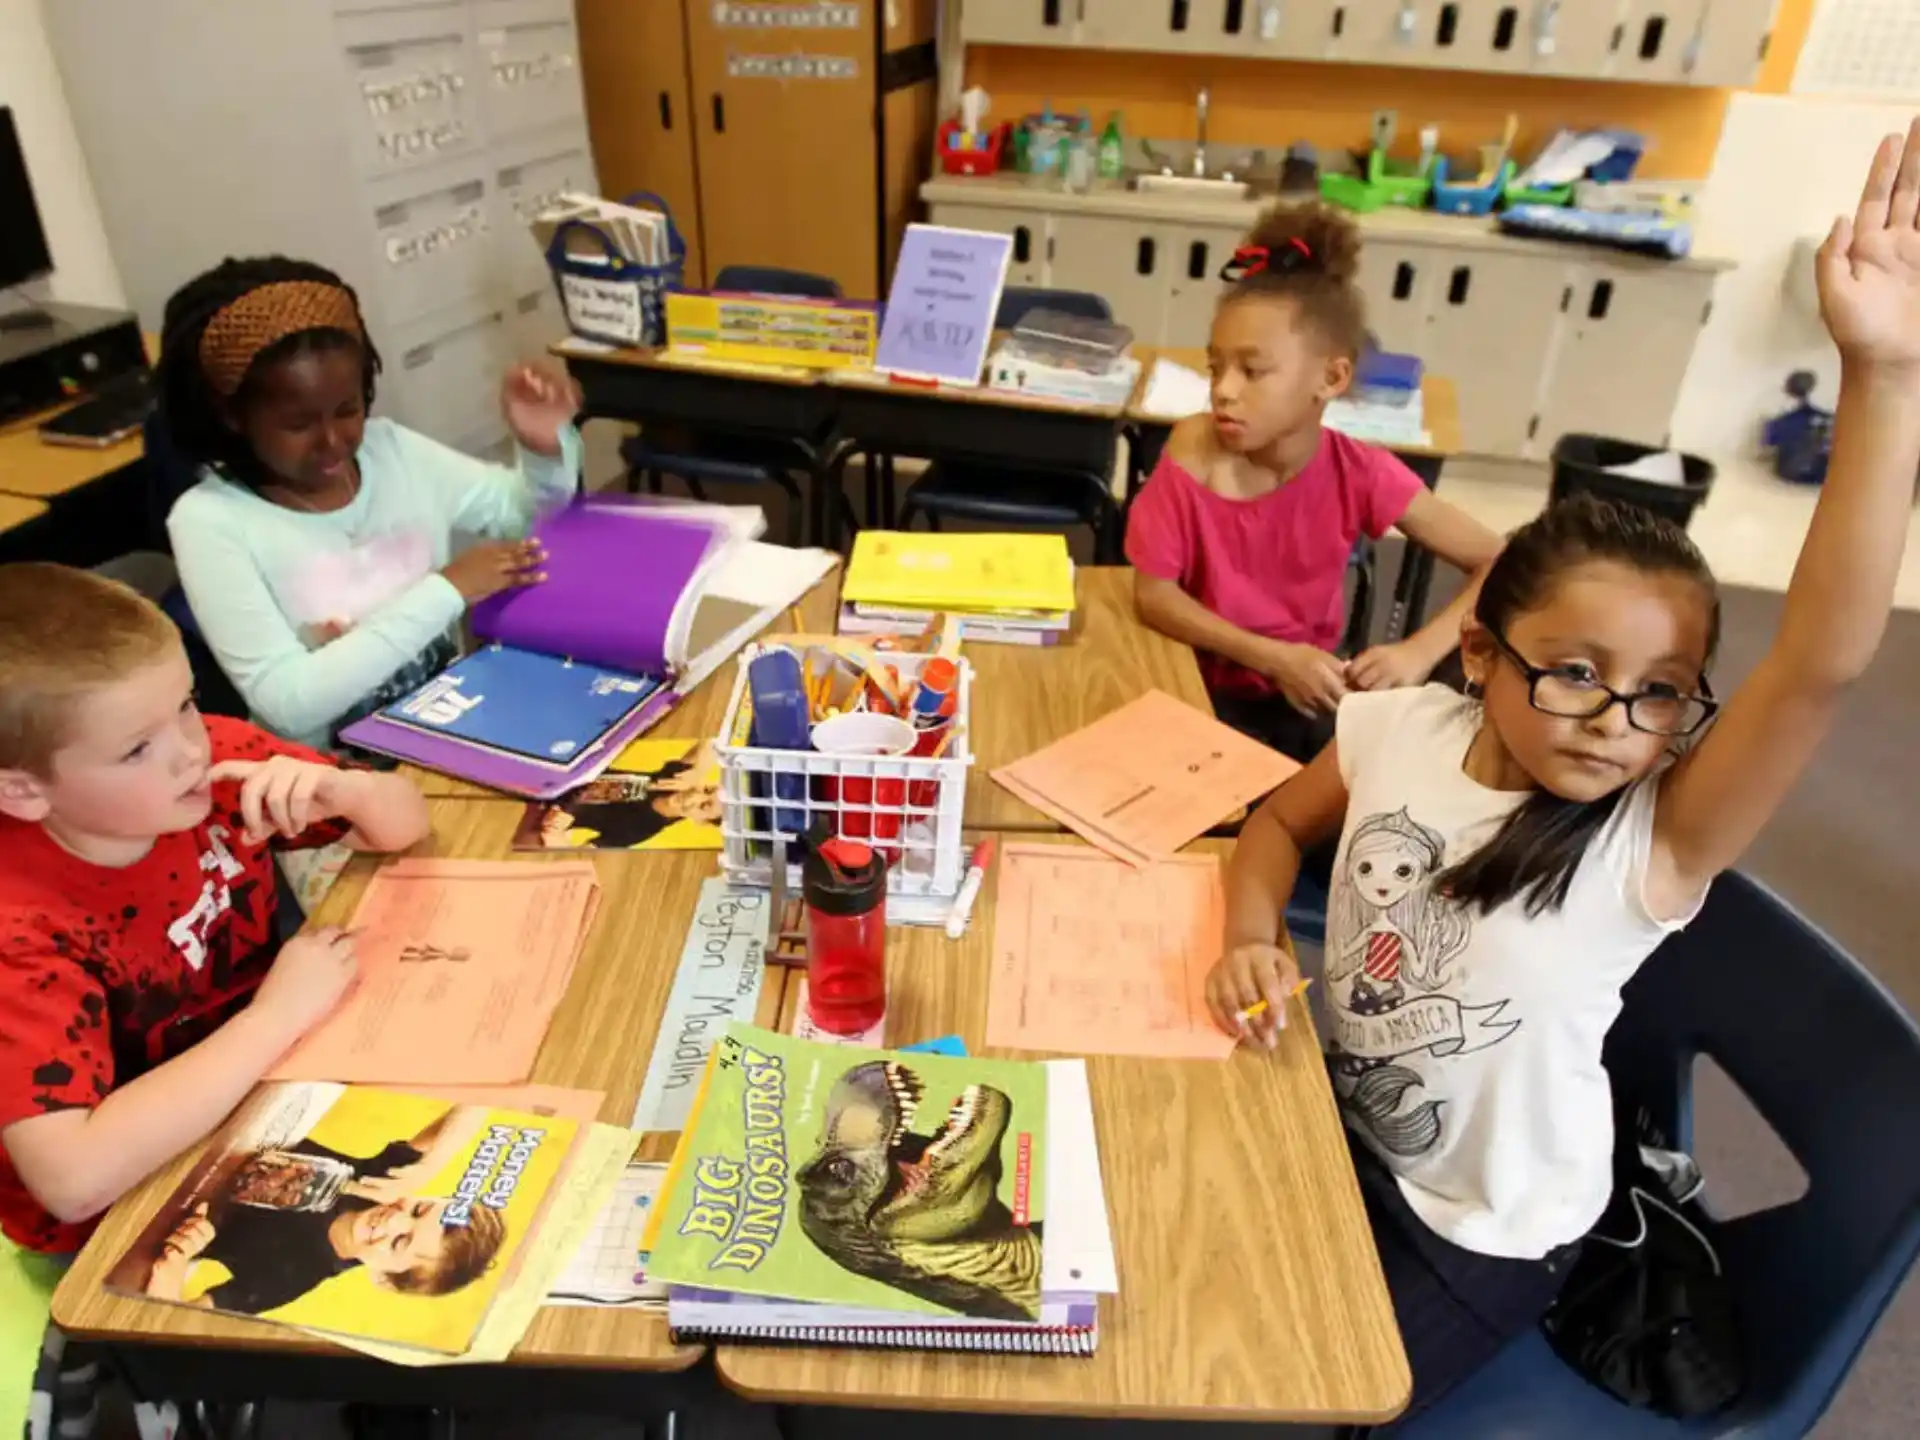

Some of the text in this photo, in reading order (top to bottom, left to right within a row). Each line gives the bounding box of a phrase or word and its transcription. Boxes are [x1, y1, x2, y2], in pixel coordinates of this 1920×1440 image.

[662, 888, 763, 1091] Peyton Maudlin
[1386, 1005, 1451, 1048] AMERICA
[440, 1124, 517, 1227] Matters!
[481, 1127, 547, 1209] Money
[678, 1156, 745, 1243] BIG
[708, 1045, 788, 1273] DINOSAURS!
